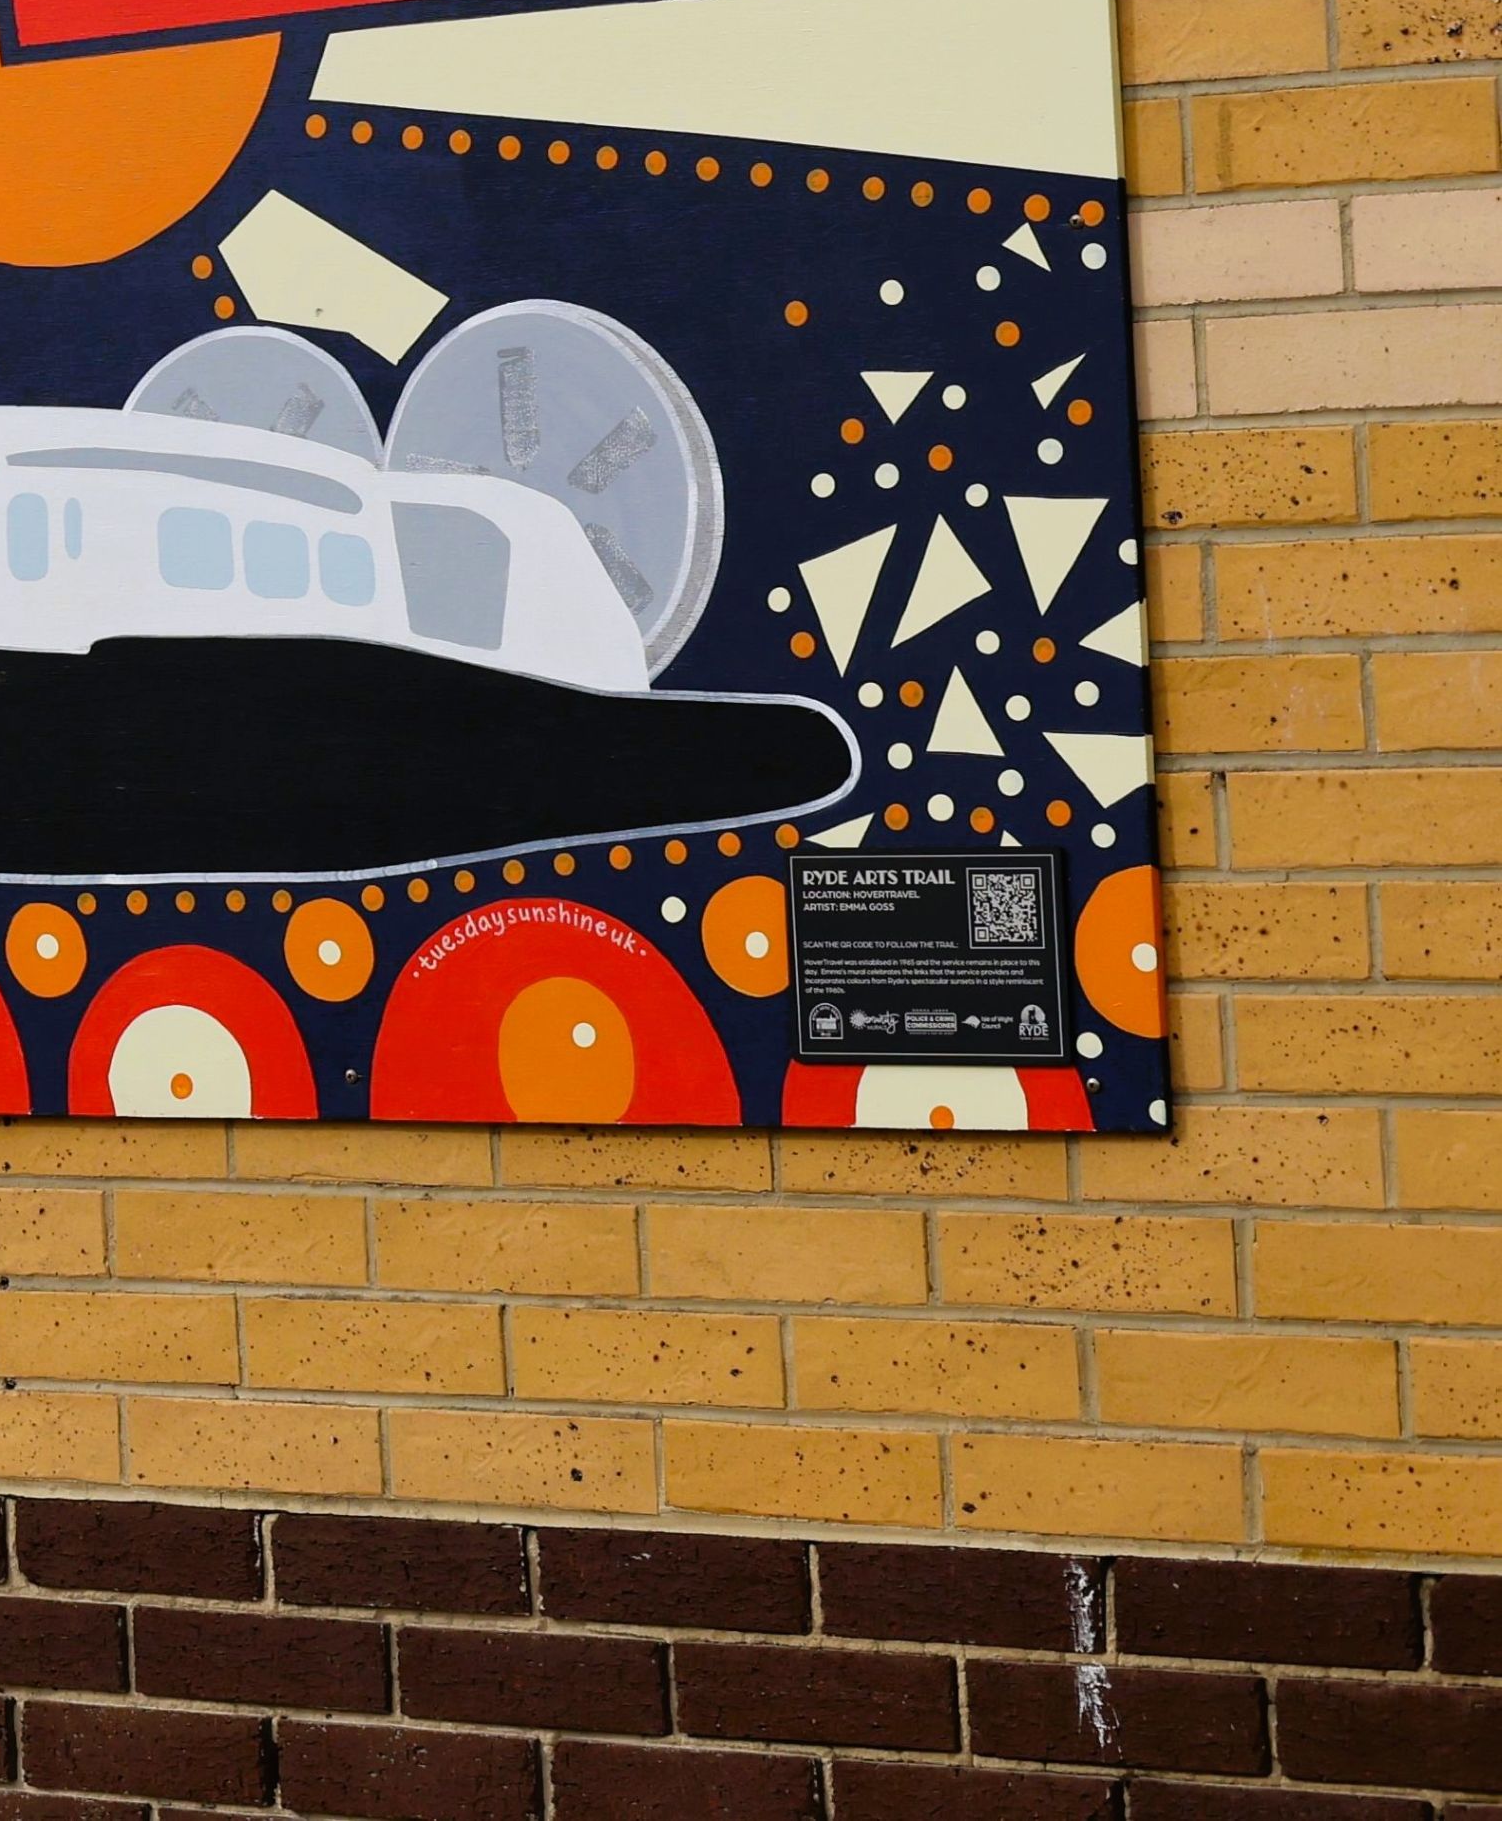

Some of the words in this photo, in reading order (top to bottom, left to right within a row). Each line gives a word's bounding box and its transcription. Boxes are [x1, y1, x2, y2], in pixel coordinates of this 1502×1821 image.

[802, 870, 849, 885] RYDE
[853, 870, 899, 885] ARTS
[902, 869, 956, 885] TRAIL
[802, 890, 852, 900] LOCATION:
[853, 890, 921, 899] HOVERTRAVEL
[803, 903, 839, 912] ARTIST:
[839, 902, 868, 912] EMMA
[869, 902, 896, 912] GOSS
[824, 941, 839, 949] THE
[853, 941, 874, 949] CODE
[874, 941, 886, 949] TO
[886, 941, 919, 949] FOLLOW
[919, 941, 935, 949] THE
[1019, 1025, 1049, 1037] RYDE
